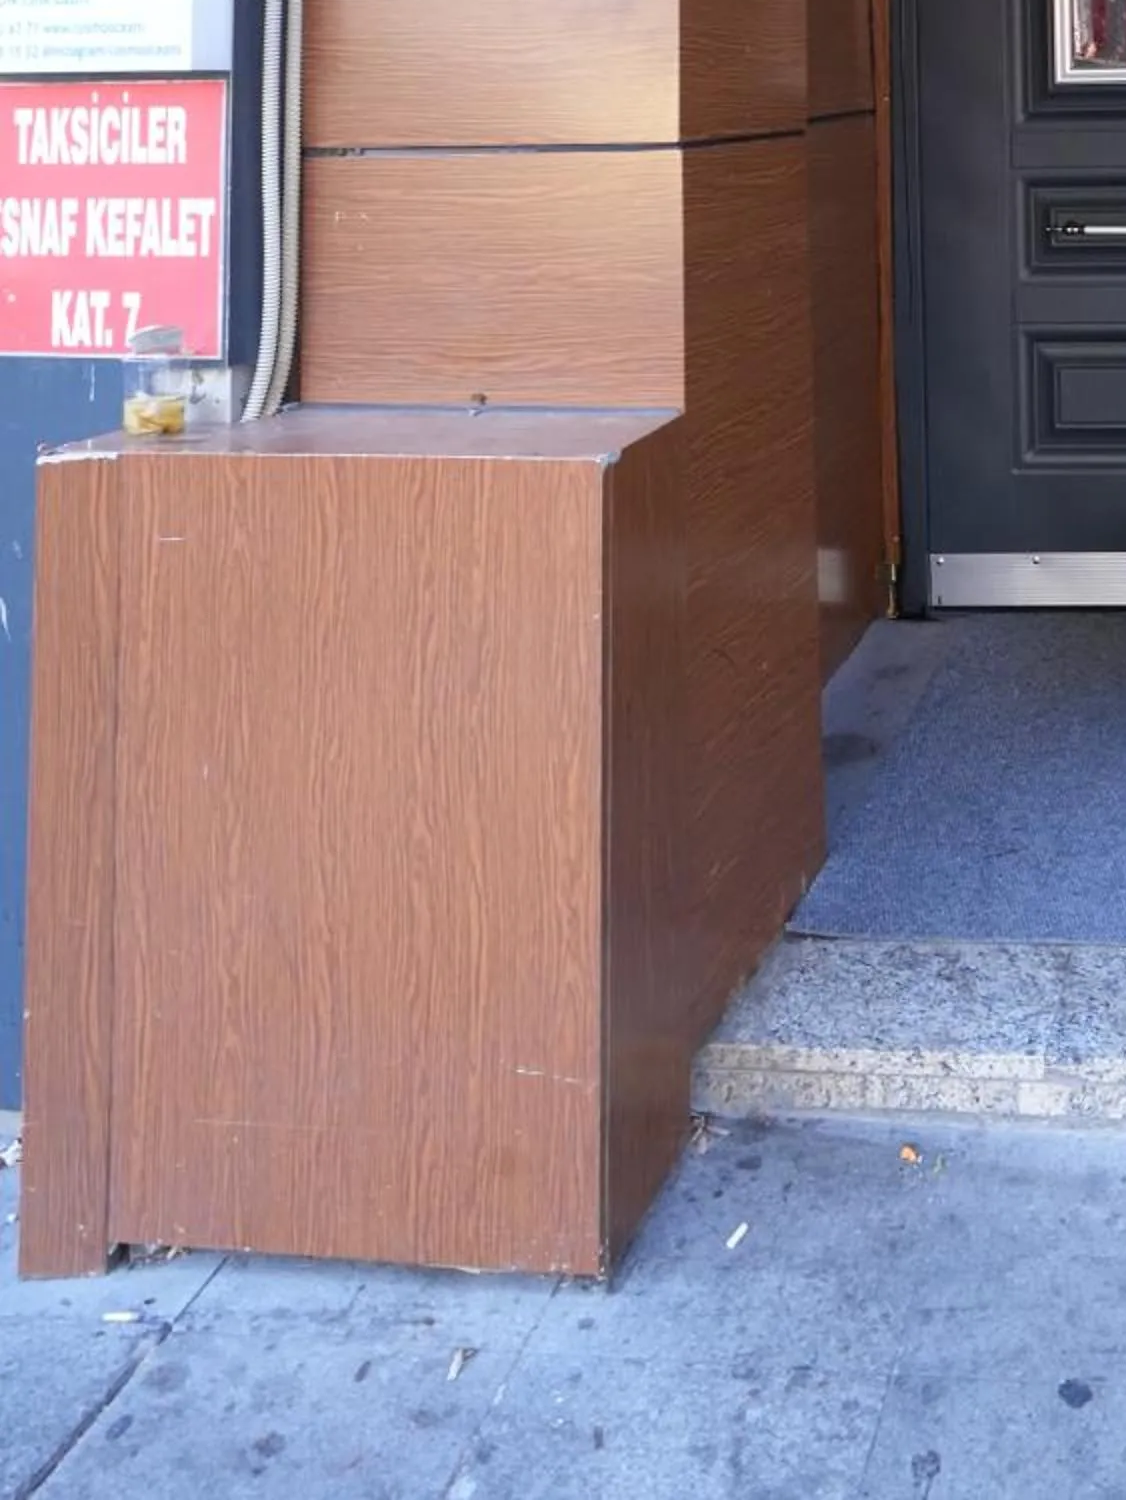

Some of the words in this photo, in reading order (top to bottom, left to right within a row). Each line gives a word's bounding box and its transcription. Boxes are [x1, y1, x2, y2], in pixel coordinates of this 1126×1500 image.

[14, 91, 188, 165] TAKSİCİLER
[0, 197, 80, 257] SNAF
[85, 196, 216, 258] KEFALET
[51, 290, 113, 348] KAT.
[123, 291, 143, 348] 7
